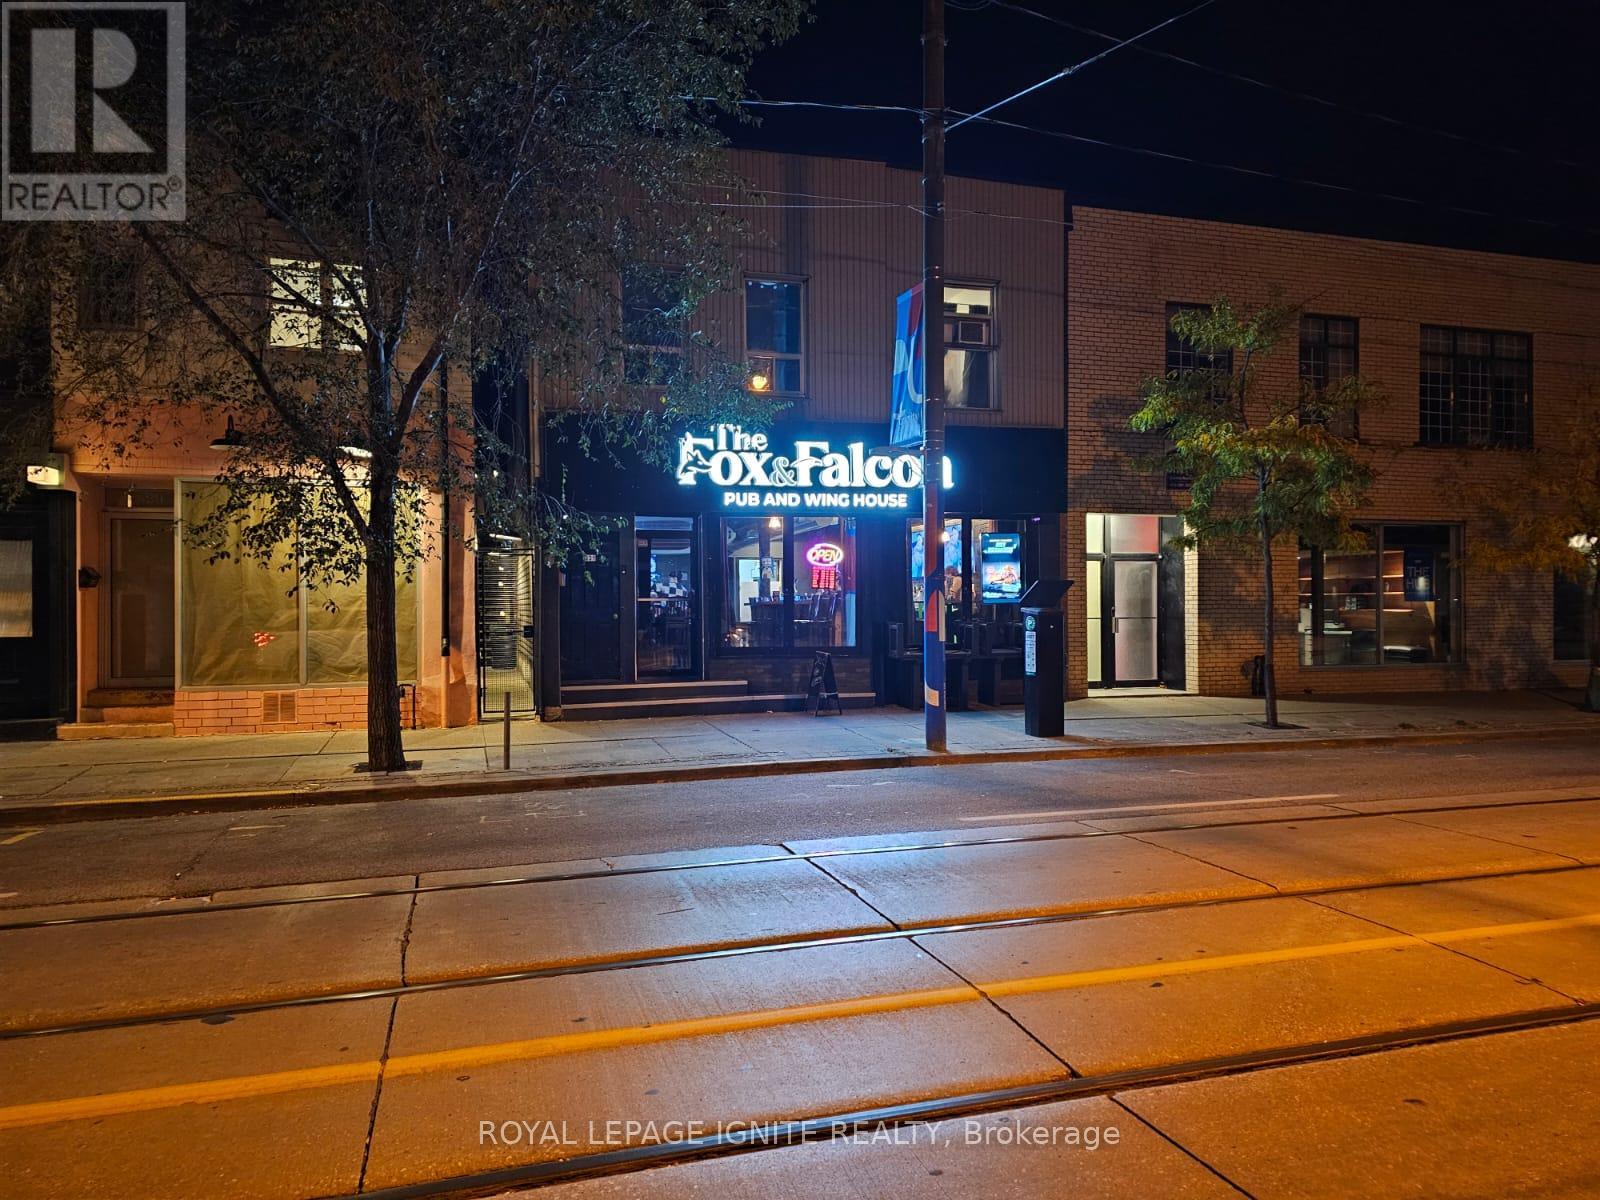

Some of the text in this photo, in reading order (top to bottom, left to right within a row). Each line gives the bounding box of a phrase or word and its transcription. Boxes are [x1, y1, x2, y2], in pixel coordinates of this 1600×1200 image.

[710, 423, 769, 452] The
[724, 492, 908, 508] PUB AND WING HOUSE
